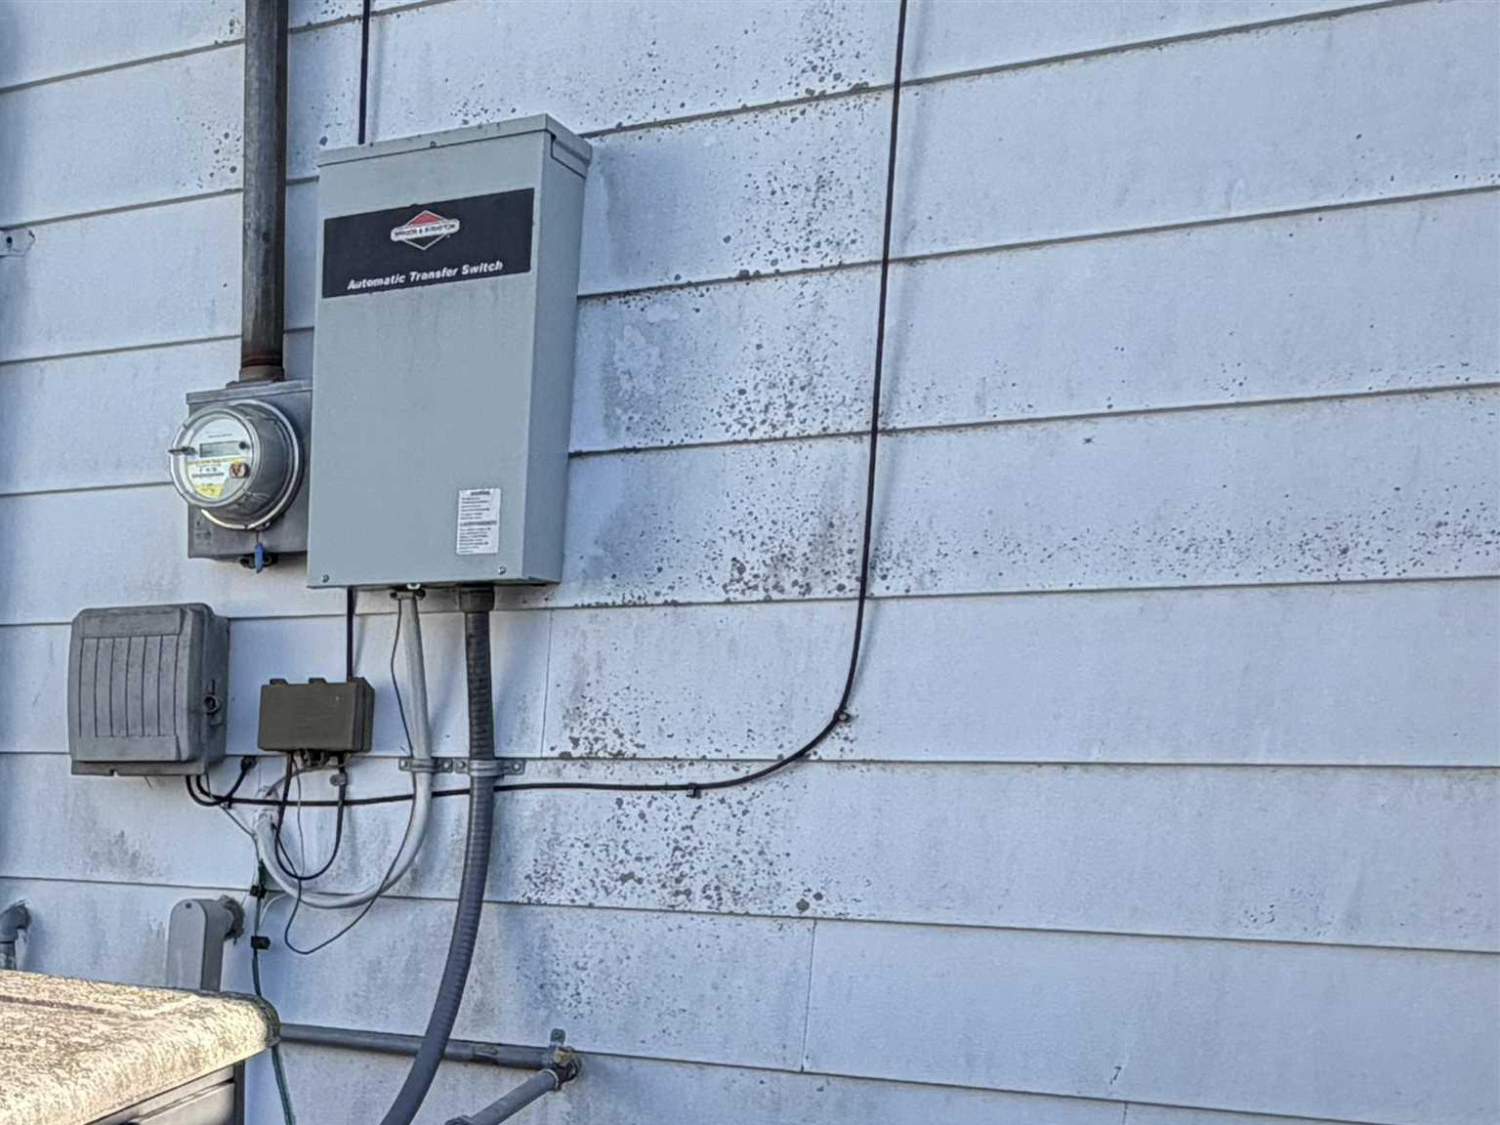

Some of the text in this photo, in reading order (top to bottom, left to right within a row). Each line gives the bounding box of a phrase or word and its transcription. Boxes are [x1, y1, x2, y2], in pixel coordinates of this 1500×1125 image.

[347, 260, 504, 290] Automatic Transfer Switch
